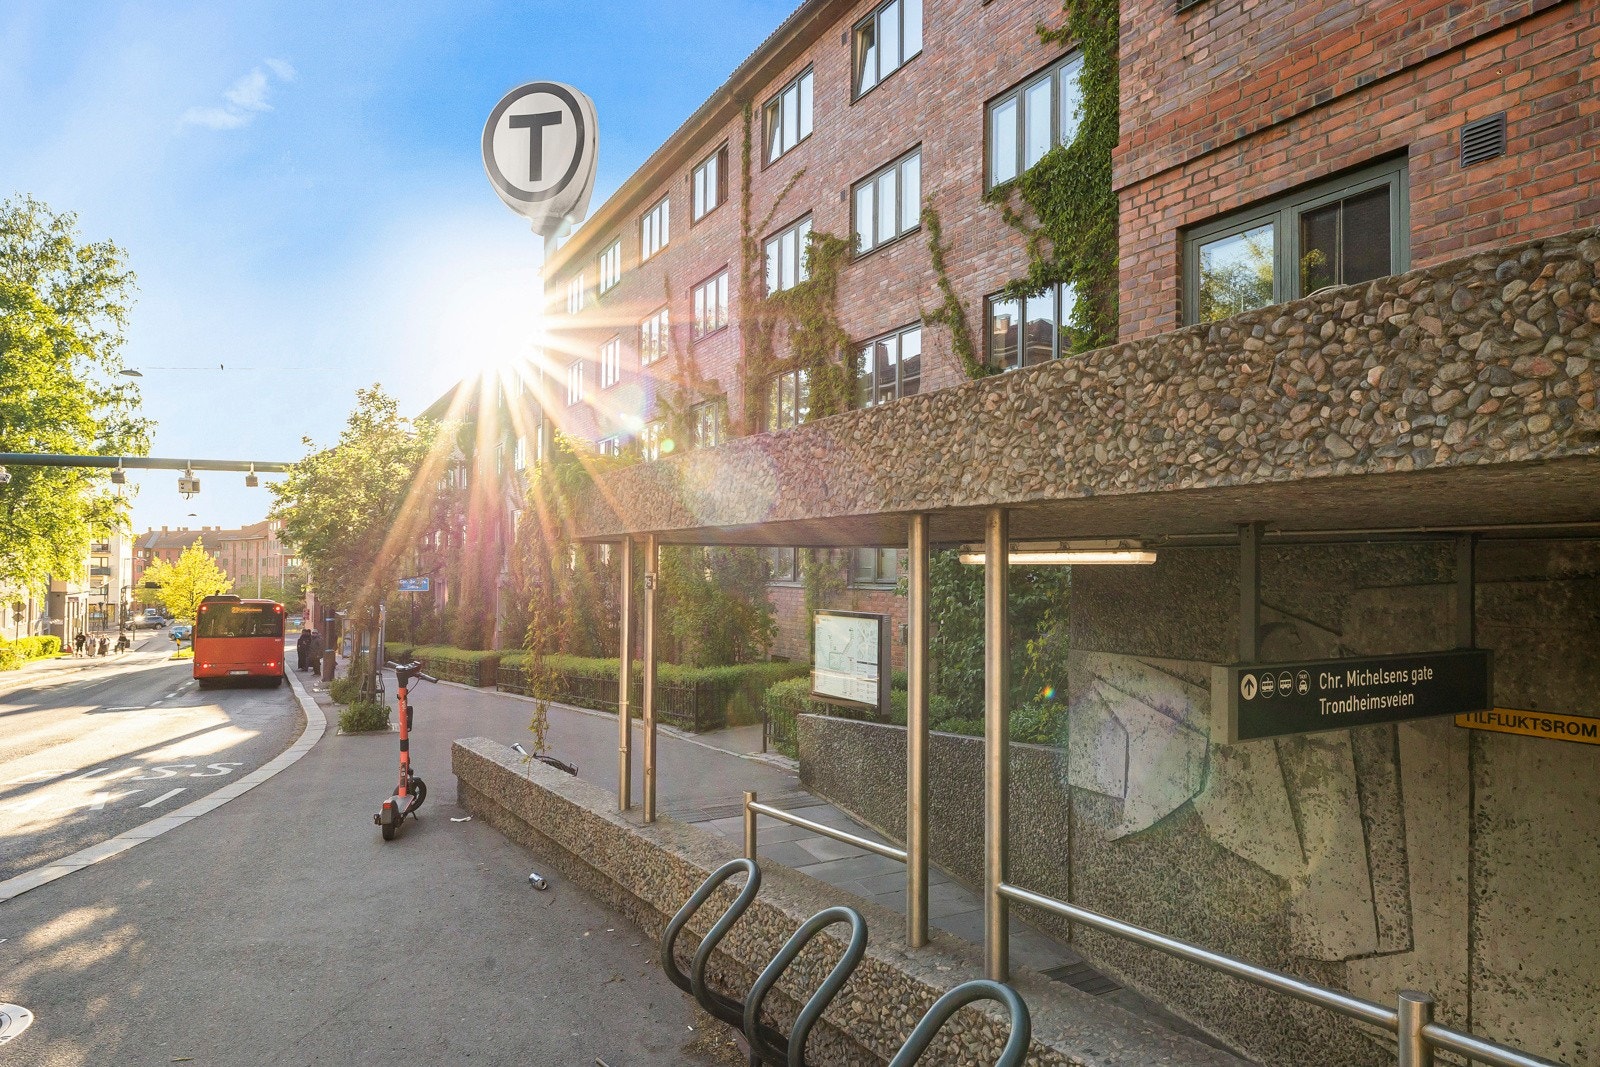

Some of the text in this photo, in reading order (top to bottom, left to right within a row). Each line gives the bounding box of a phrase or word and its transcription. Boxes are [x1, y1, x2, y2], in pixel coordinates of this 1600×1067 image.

[509, 110, 562, 182] T
[1319, 666, 1433, 690] Chr. Michelsens gate
[1319, 690, 1414, 715] Trondheimsveien
